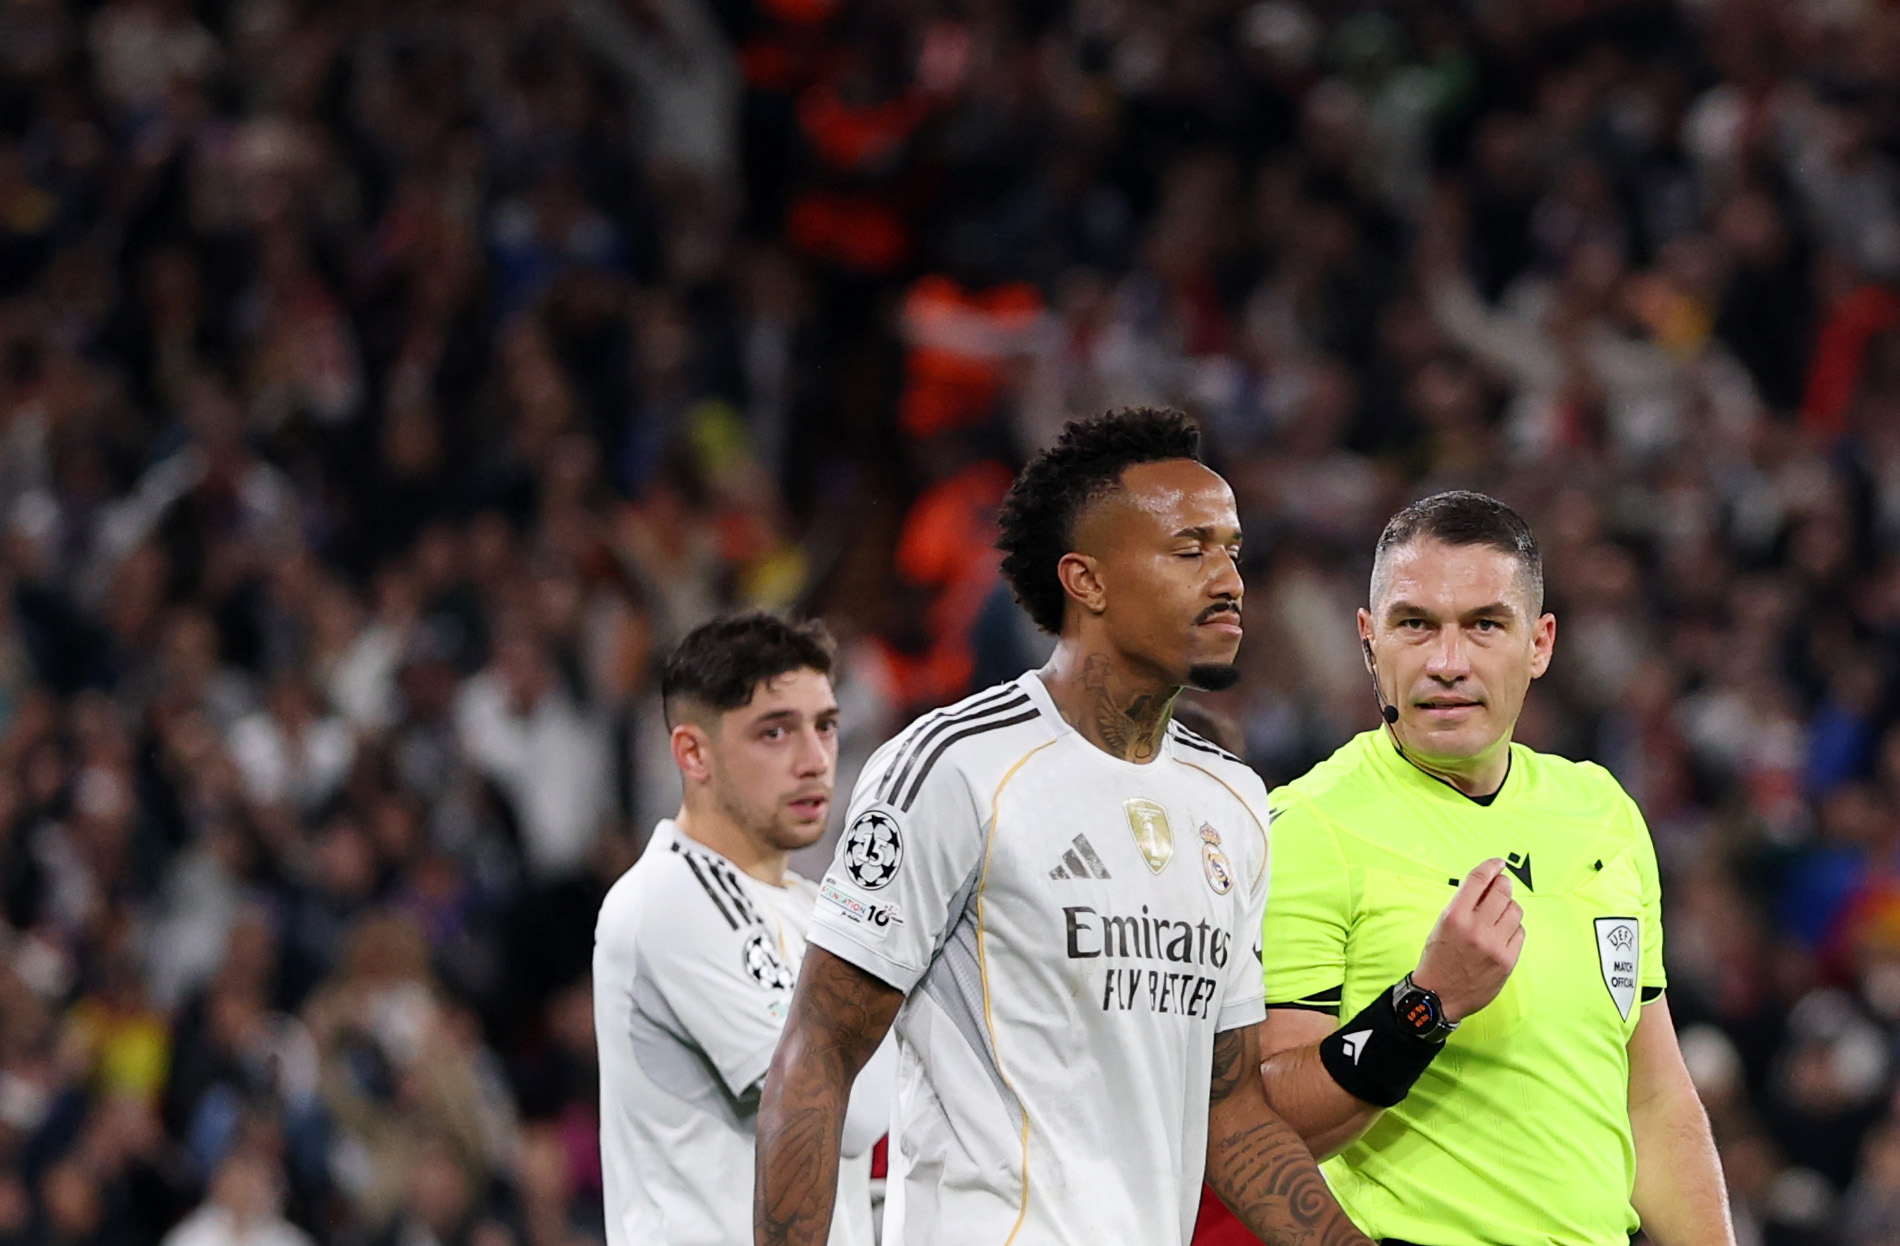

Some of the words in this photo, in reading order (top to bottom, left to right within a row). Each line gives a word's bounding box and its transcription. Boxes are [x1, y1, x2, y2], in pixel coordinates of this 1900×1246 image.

[858, 833, 889, 867] 15
[1062, 904, 1231, 969] Emirates
[1609, 929, 1633, 947] UEFA
[1102, 968, 1142, 1011] FLY
[1148, 970, 1217, 1020] BETTER
